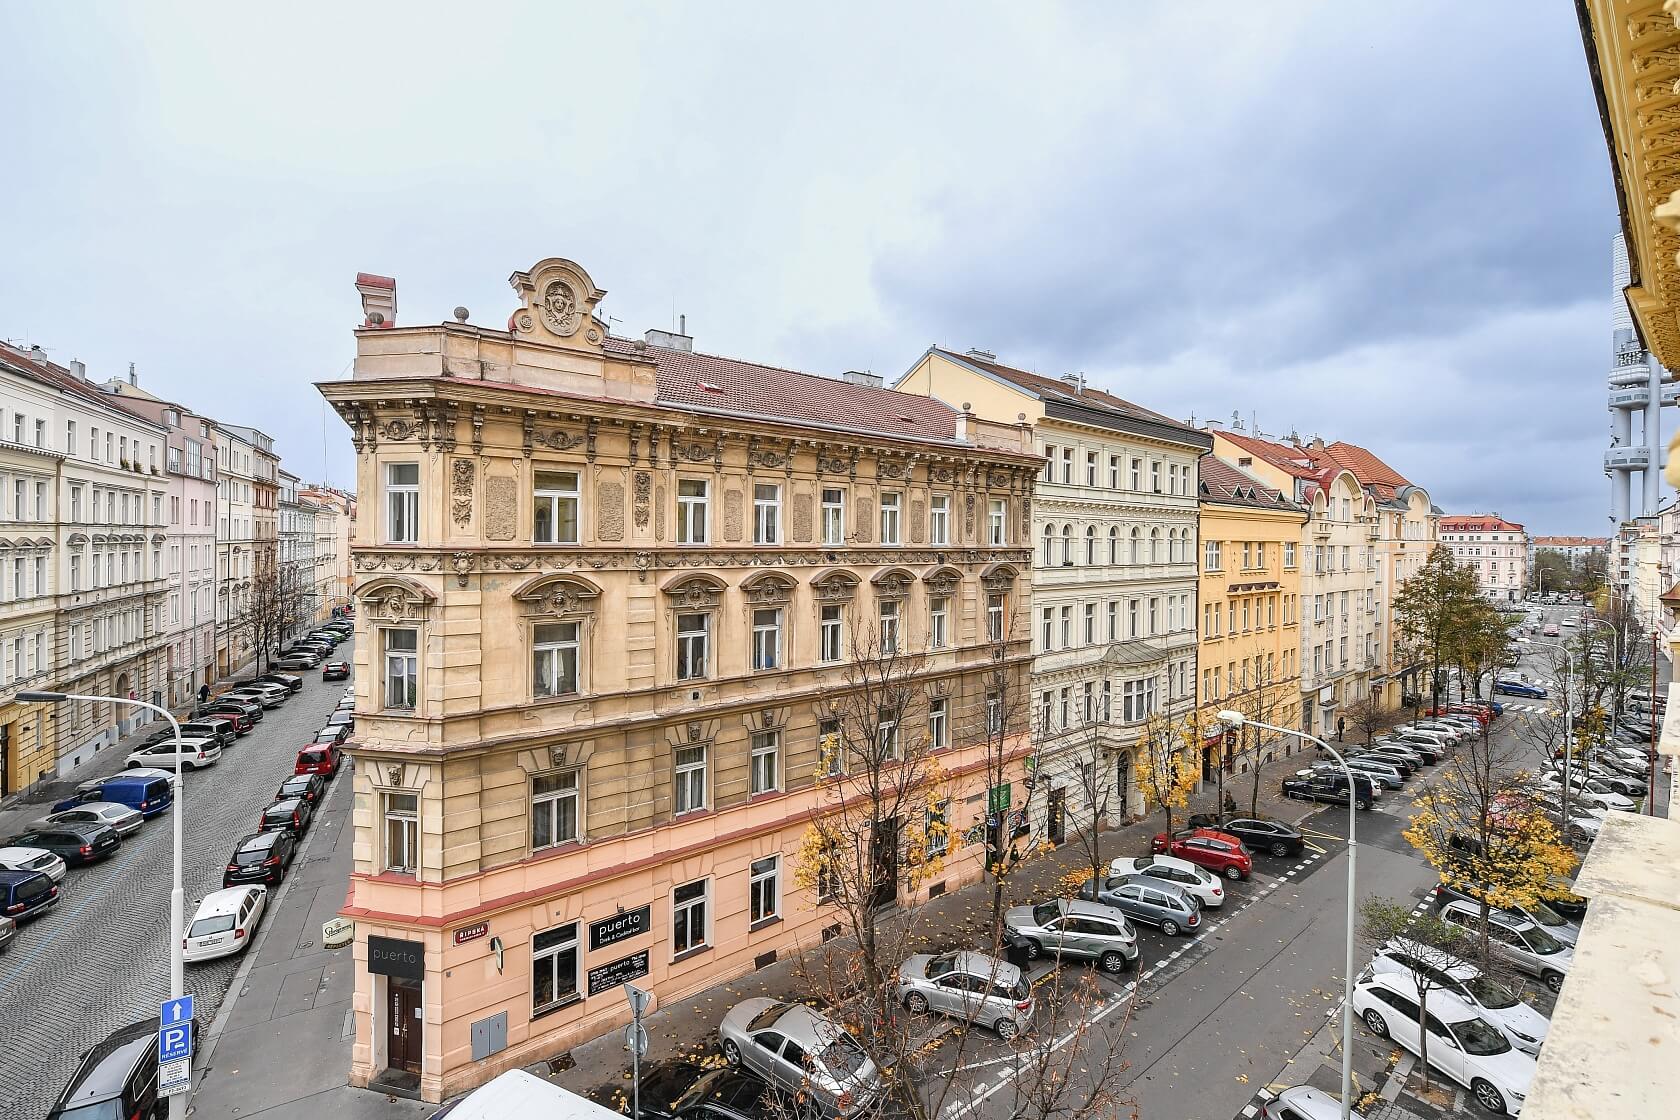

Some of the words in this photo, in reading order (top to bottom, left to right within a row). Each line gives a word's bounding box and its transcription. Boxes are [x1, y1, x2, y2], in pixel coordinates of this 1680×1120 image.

[600, 915, 640, 938] puerto
[373, 949, 416, 964] puerto
[610, 960, 630, 972] puerto
[165, 1029, 184, 1051] P
